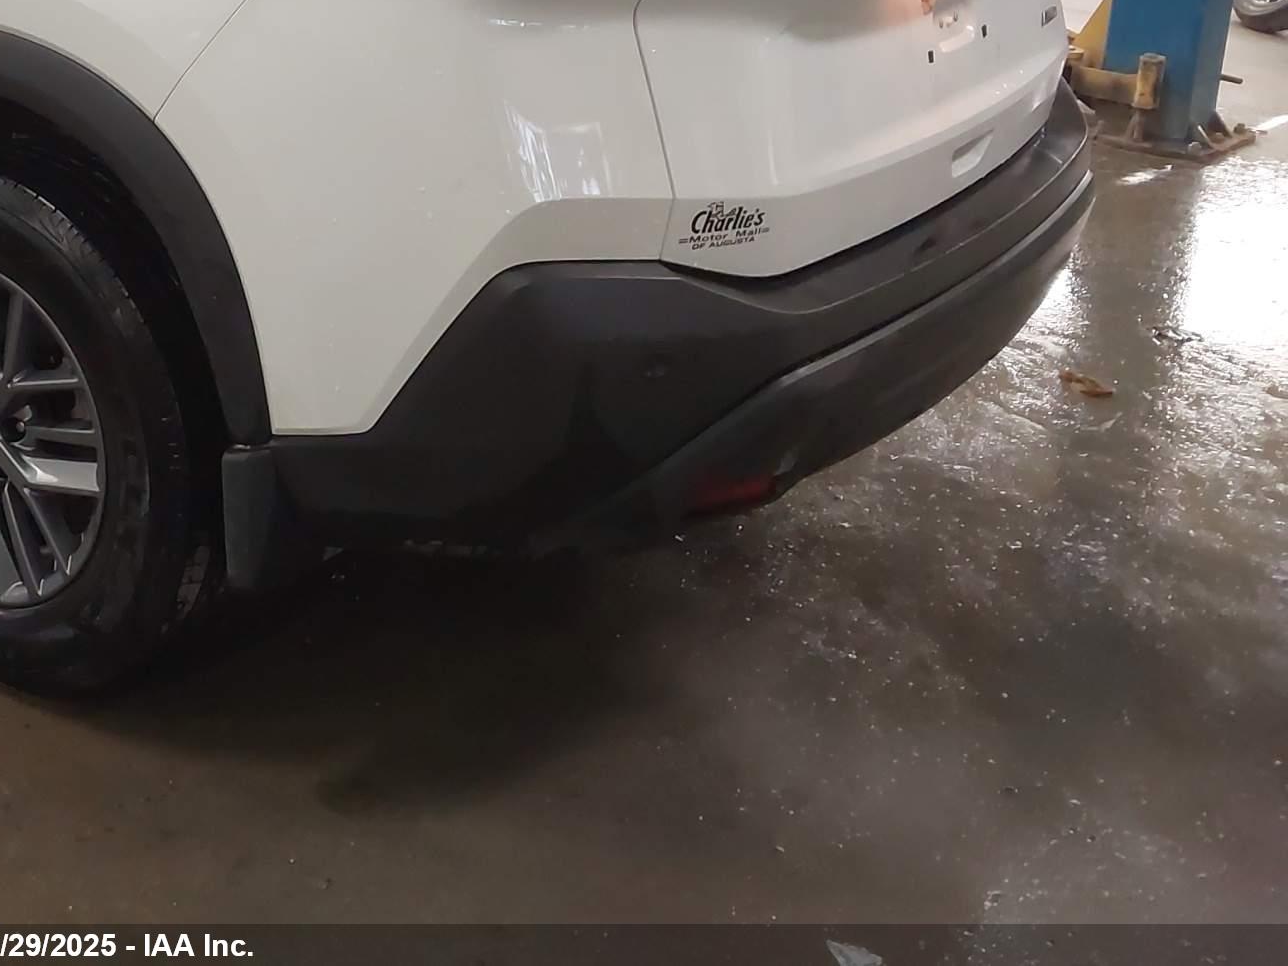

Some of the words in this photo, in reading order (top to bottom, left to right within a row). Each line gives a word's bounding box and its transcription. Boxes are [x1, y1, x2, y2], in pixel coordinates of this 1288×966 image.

[691, 206, 766, 234] Charlie's
[689, 233, 729, 244] Motor
[735, 227, 761, 238] Mall
[691, 242, 706, 251] OF
[708, 236, 755, 248] AUGUSTA
